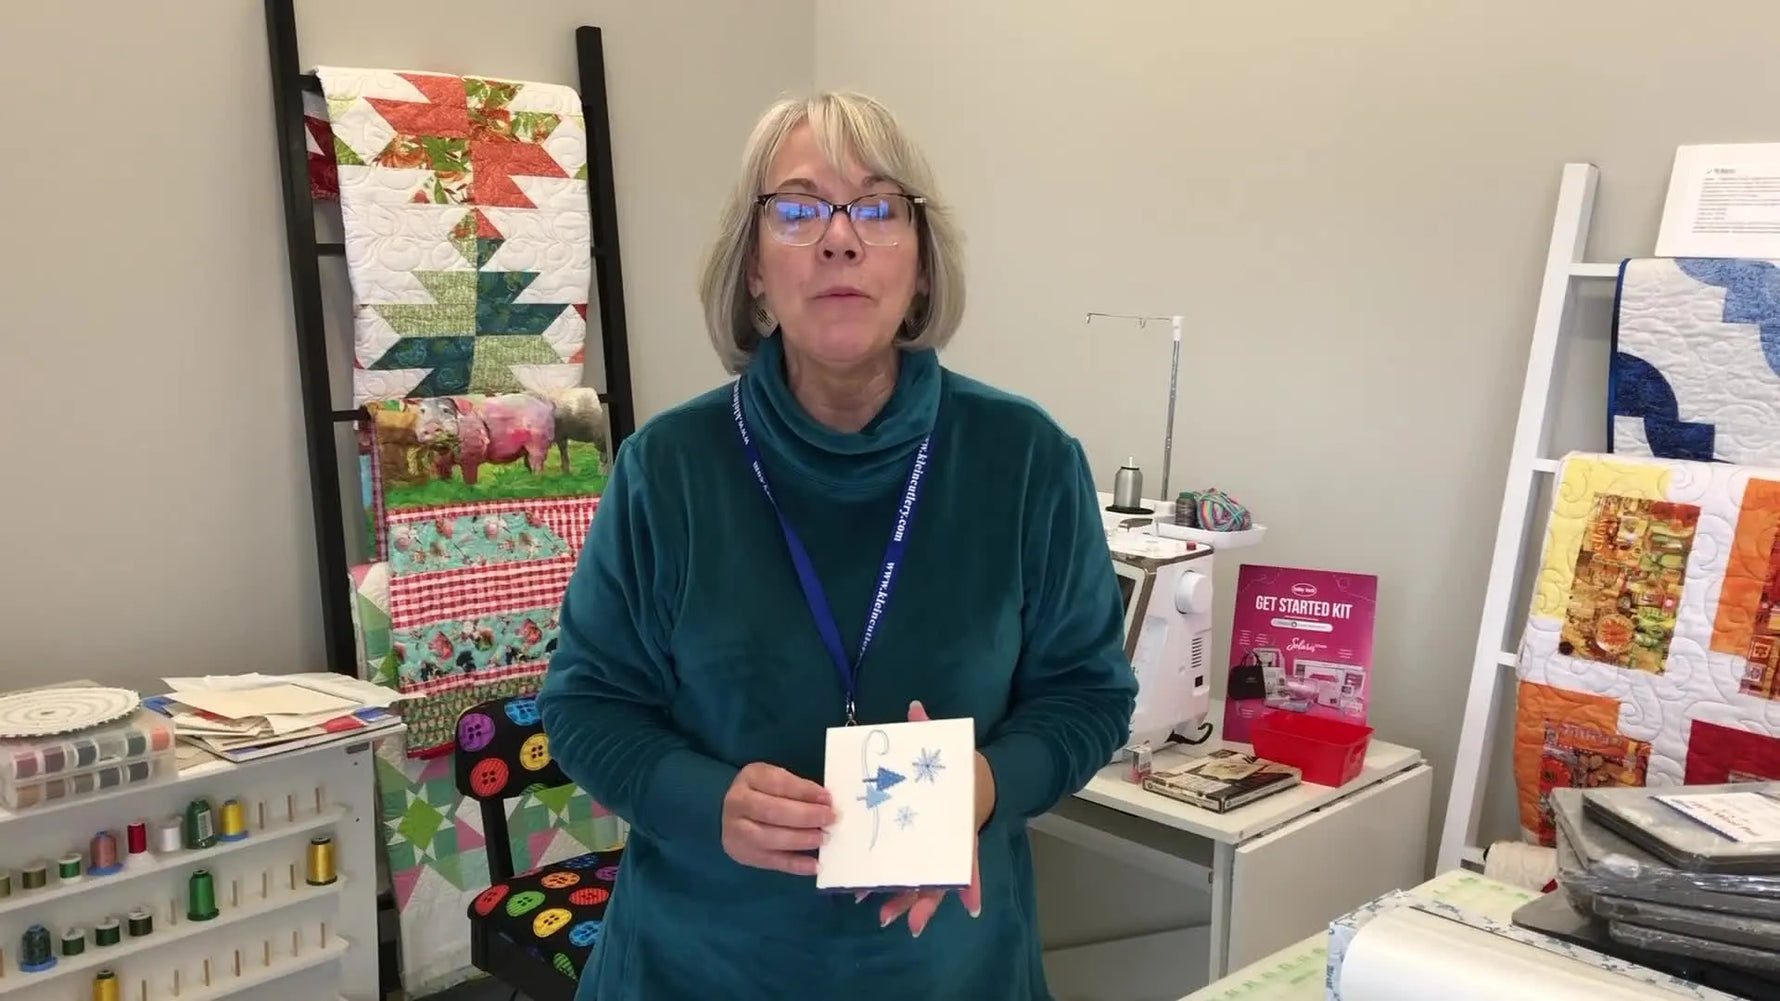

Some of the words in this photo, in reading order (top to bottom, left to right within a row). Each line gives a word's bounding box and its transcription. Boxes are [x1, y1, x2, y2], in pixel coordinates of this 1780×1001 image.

[1256, 595, 1277, 611] GET
[1279, 597, 1330, 617] STARTED
[1332, 603, 1353, 619] KIT
